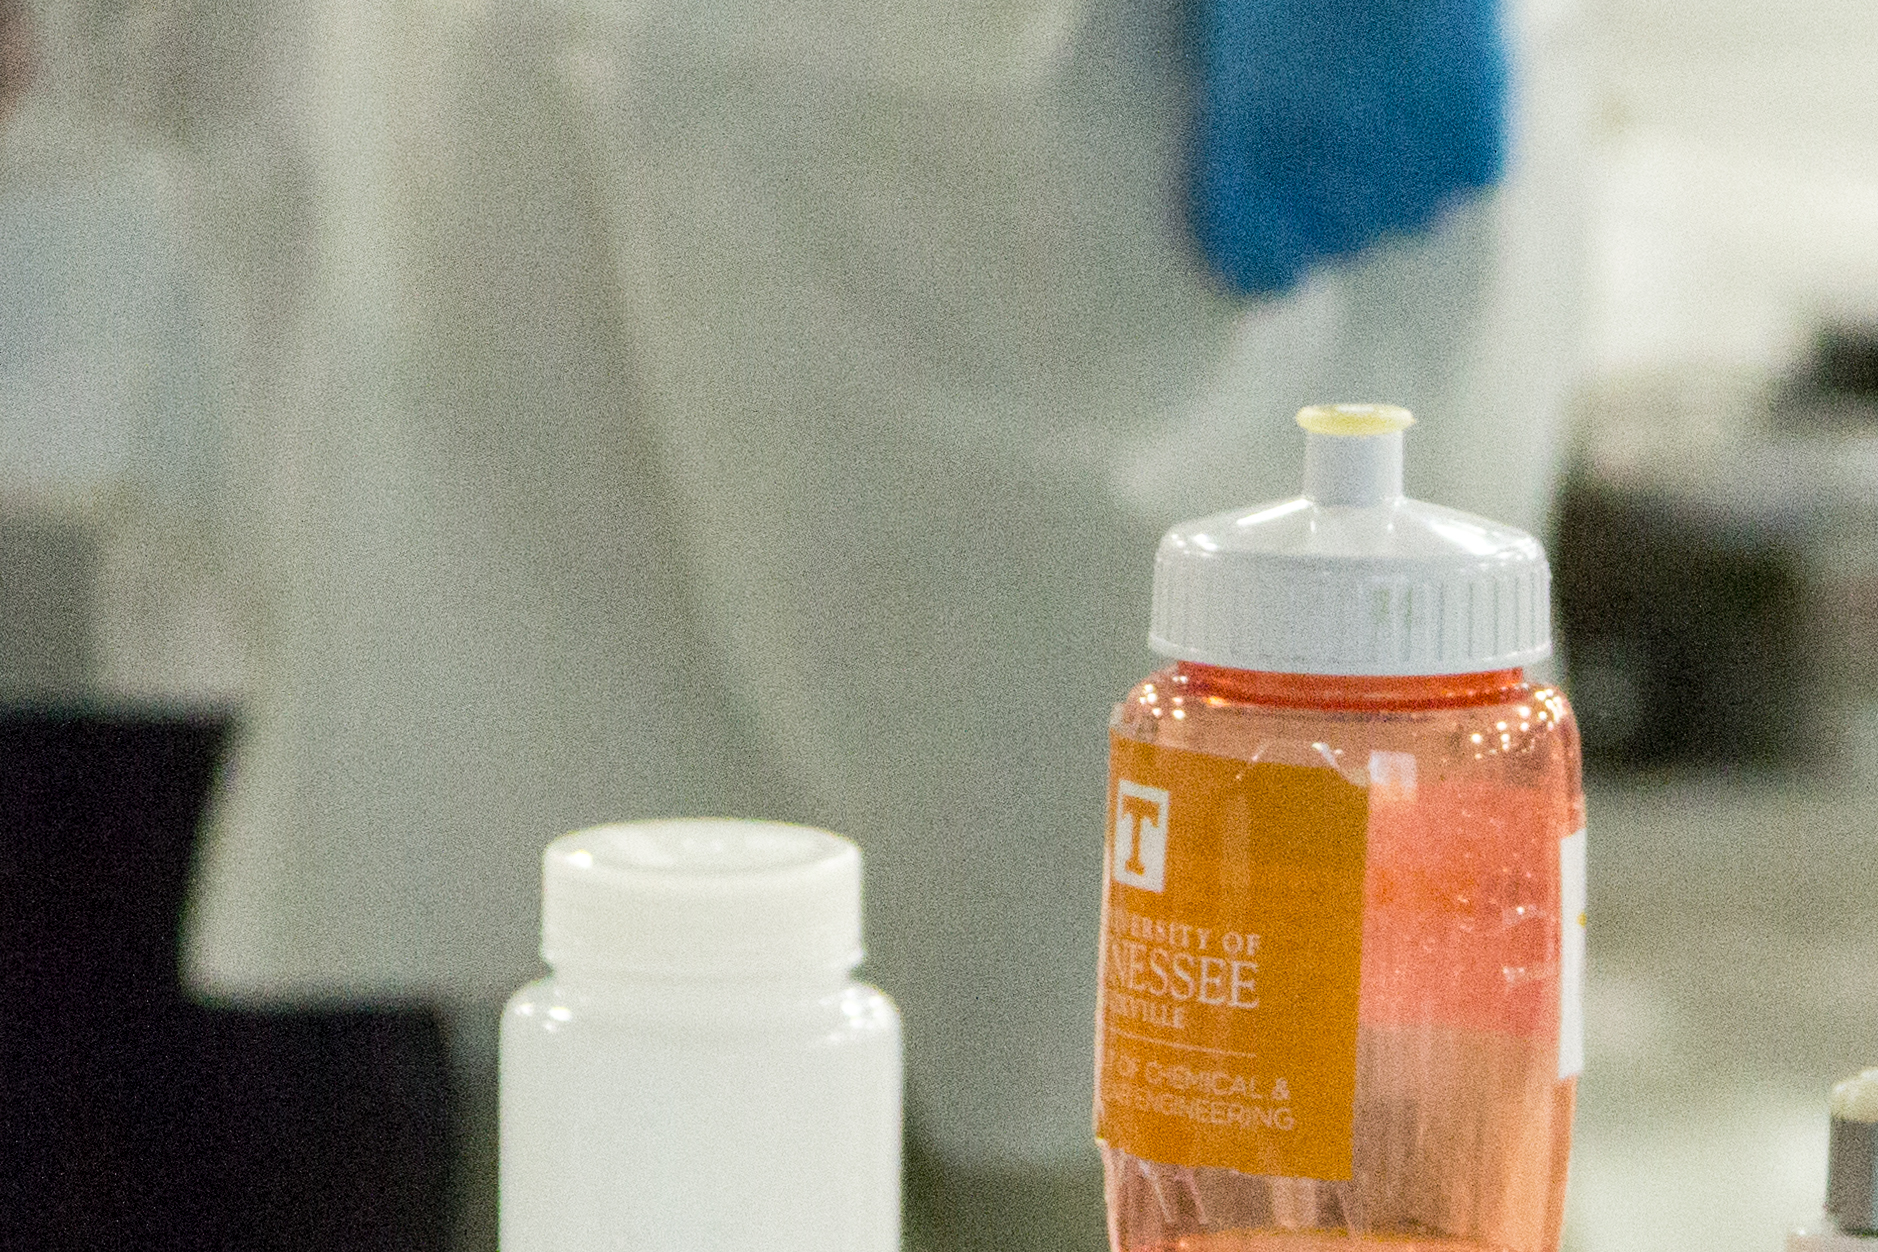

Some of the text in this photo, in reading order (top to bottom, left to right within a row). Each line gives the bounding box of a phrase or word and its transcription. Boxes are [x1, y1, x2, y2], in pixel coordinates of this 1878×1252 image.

[1122, 793, 1160, 876] T
[1112, 908, 1262, 957] ERSITY OF
